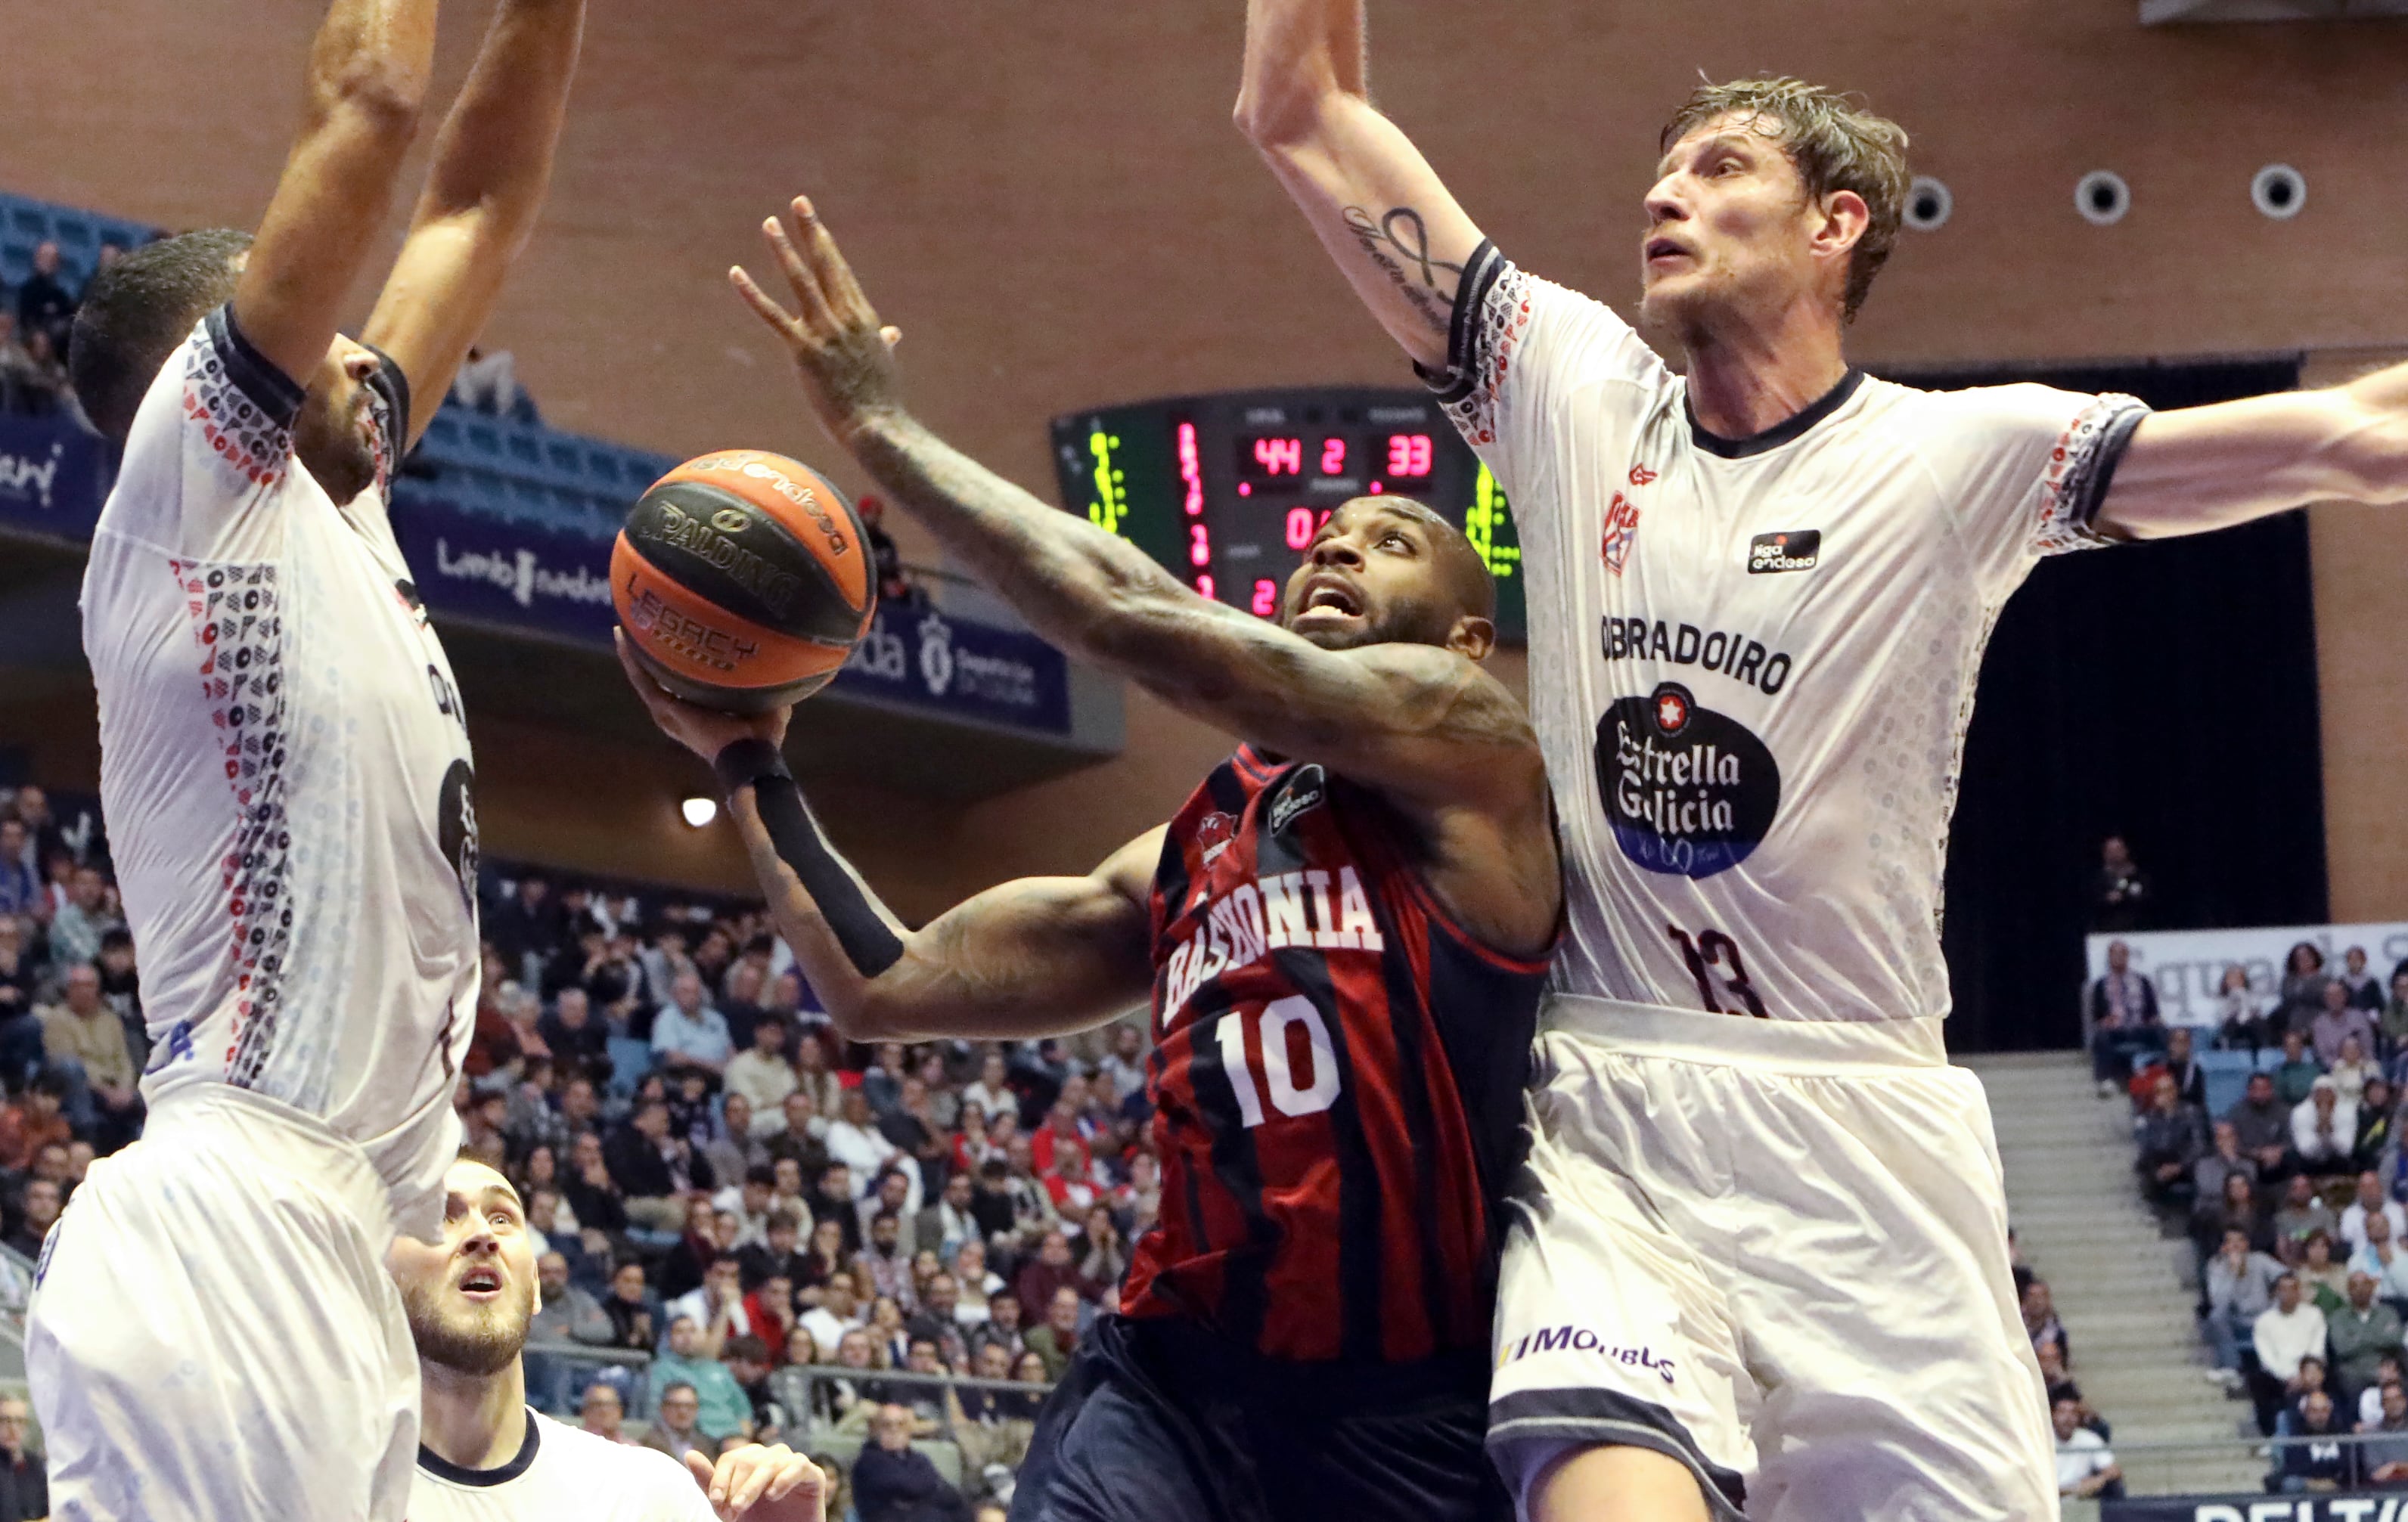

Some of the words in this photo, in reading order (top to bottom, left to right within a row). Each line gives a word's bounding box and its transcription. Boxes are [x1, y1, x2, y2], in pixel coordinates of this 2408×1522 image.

[1255, 438, 1302, 475] 44
[1321, 438, 1345, 474] 2
[1387, 434, 1432, 476] 33
[1752, 555, 1815, 569] endesa
[1754, 544, 1783, 557] liga
[626, 572, 759, 659] LEGACY
[1252, 579, 1277, 615] 2
[1162, 866, 1385, 1029] BASKONIA
[1215, 994, 1342, 1129] 10
